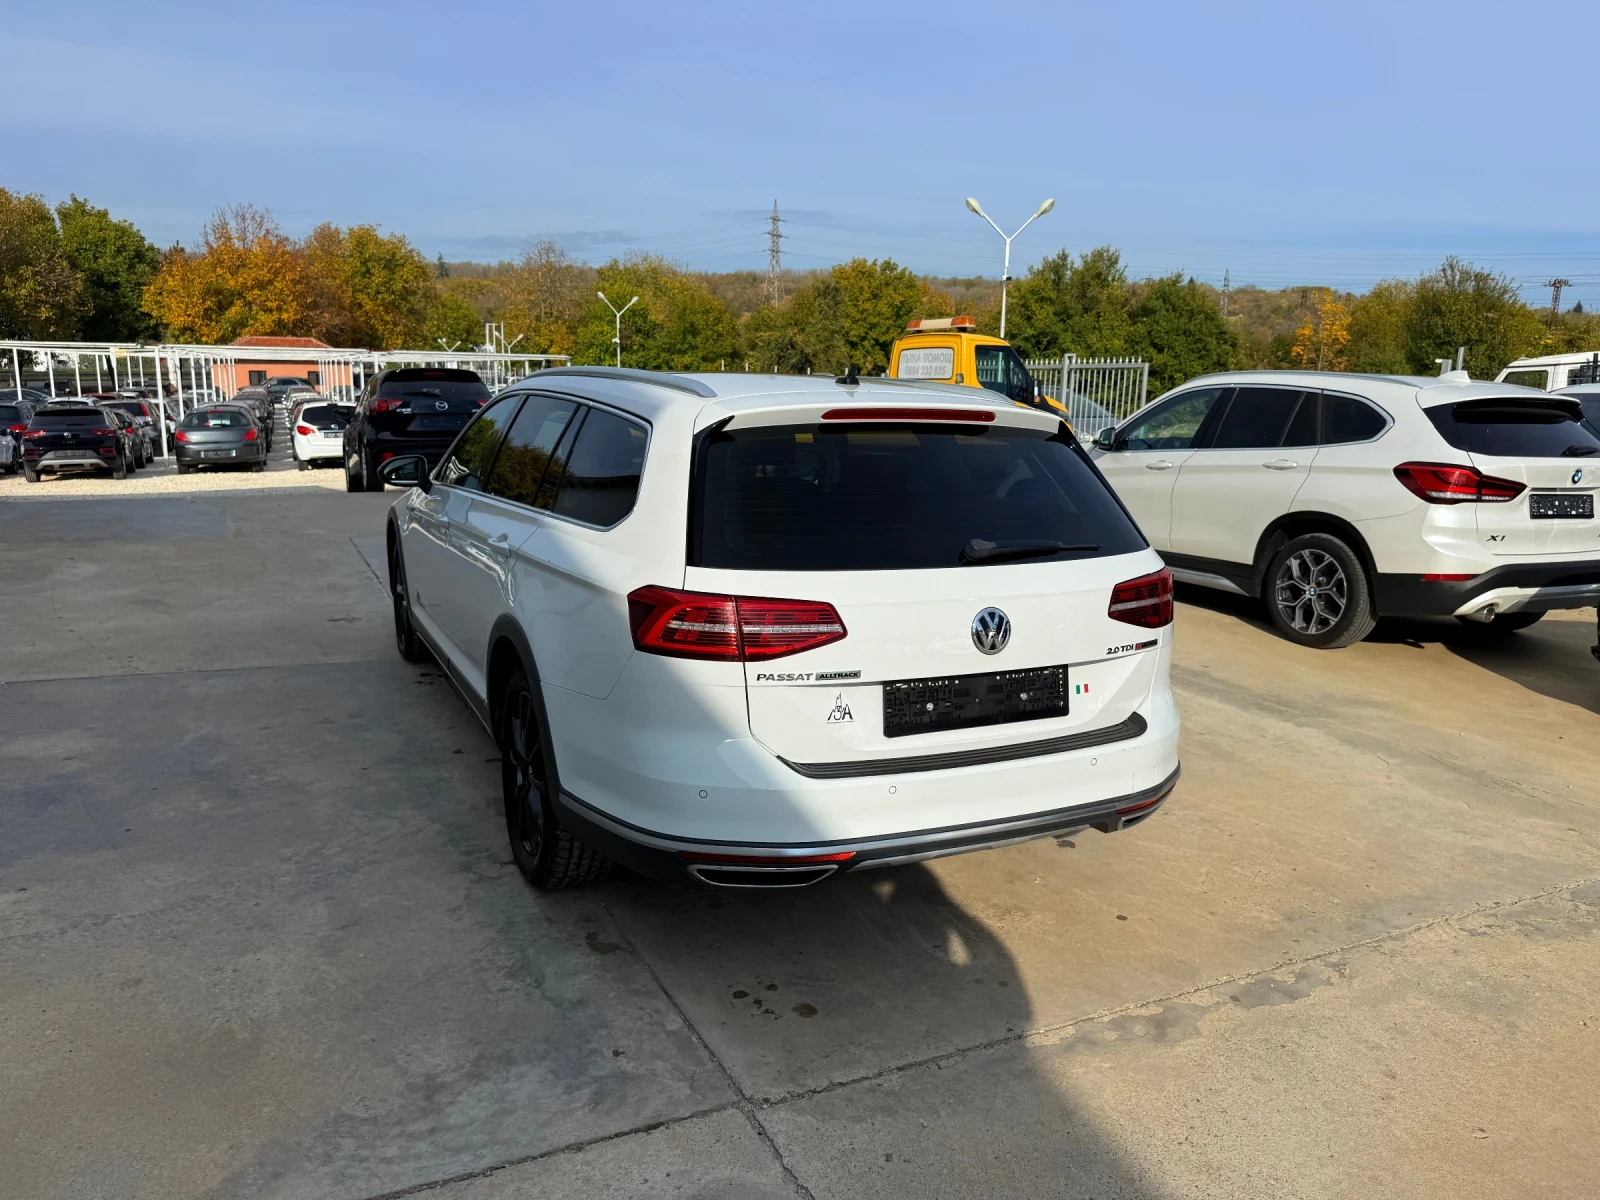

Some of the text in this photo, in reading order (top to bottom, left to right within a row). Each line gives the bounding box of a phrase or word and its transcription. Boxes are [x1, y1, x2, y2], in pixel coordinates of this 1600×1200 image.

[923, 352, 952, 364] ПОМОЩ
[1106, 647, 1120, 655] 2.0
[1120, 643, 1134, 653] TDI
[756, 671, 858, 681] PASSAT ALLTRACK
